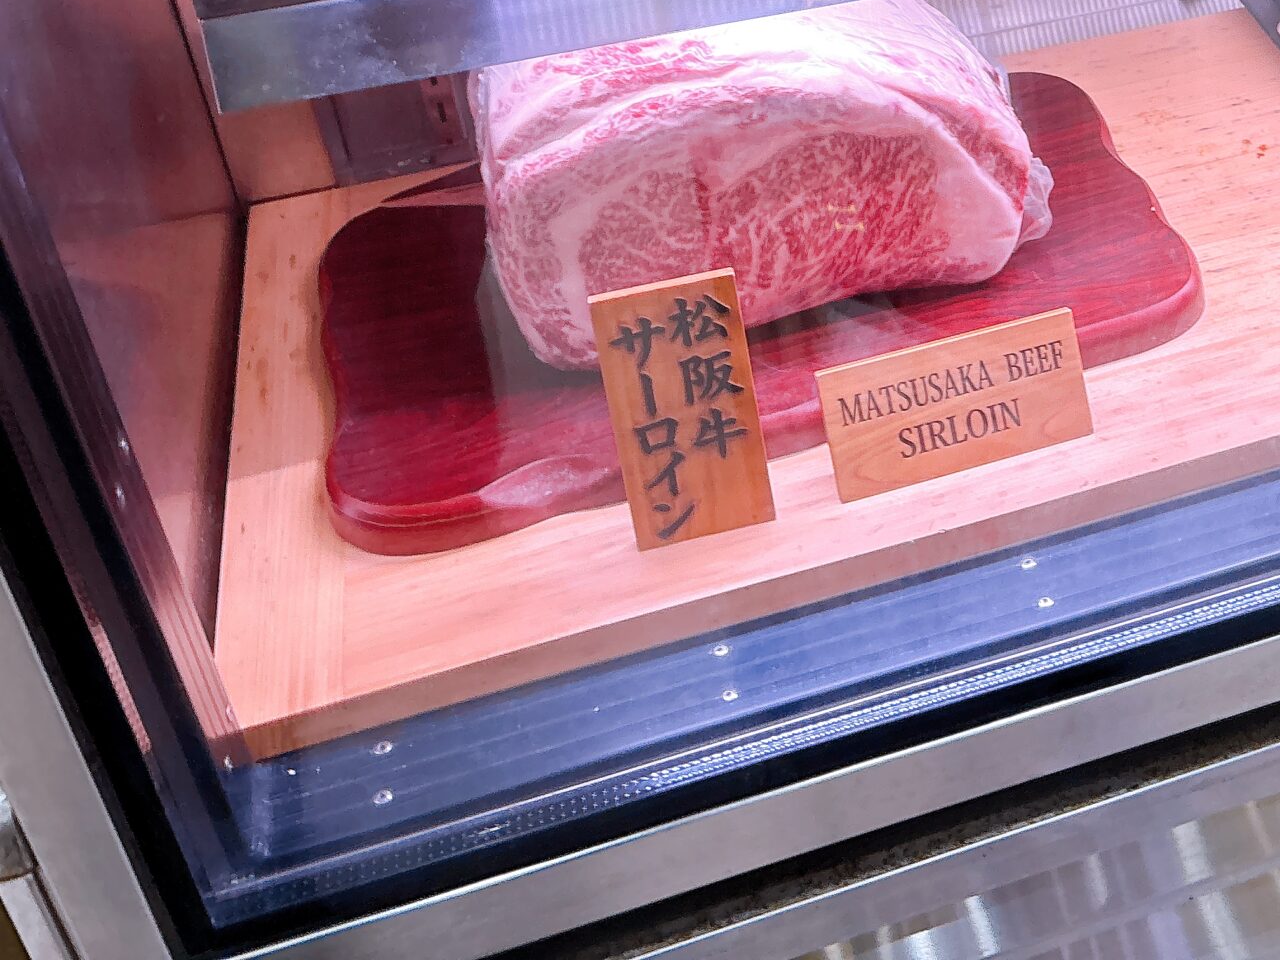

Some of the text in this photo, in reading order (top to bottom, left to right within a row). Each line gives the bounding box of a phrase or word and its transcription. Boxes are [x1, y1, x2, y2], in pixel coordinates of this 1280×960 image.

[610, 317, 697, 541] サーロイン
[668, 292, 749, 460] 松阪牛
[837, 340, 1066, 427] MATSUSAKA BEEF
[898, 398, 1023, 460] SIRLOIN
